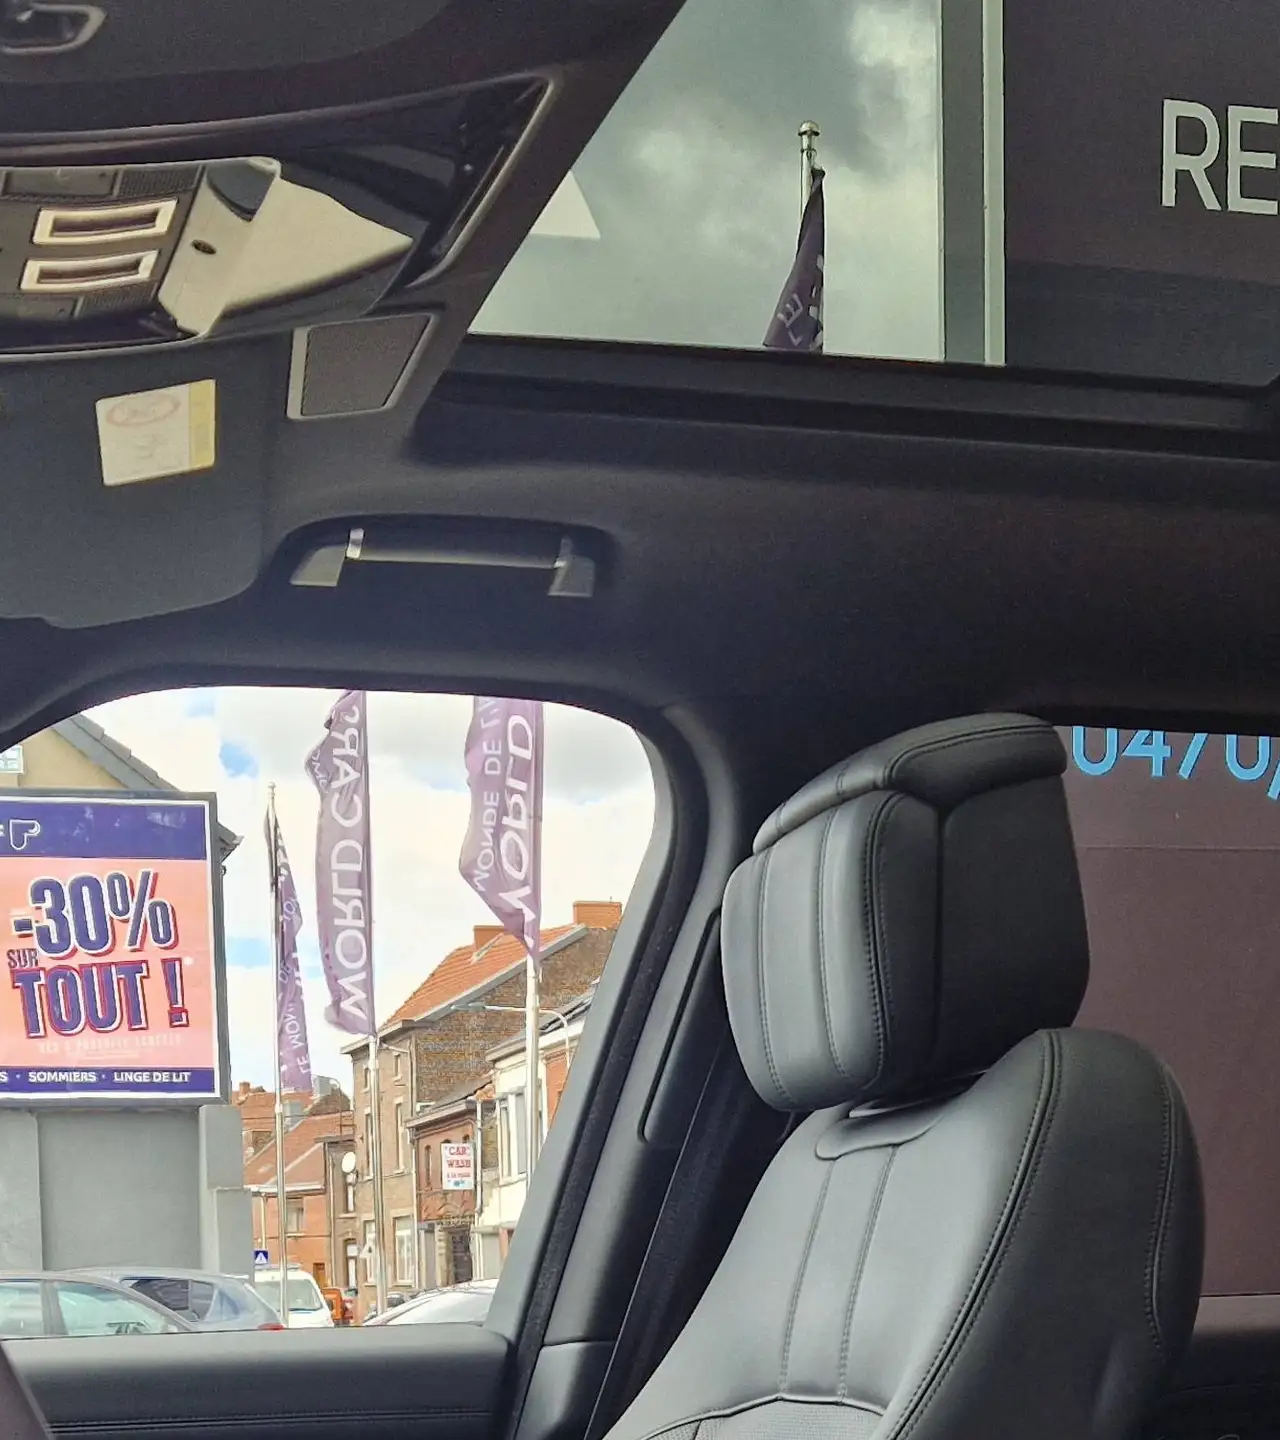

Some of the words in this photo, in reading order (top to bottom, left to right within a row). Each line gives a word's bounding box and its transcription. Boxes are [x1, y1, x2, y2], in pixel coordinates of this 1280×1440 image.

[12, 868, 178, 957] -30%
[7, 948, 38, 968] SUR
[10, 960, 149, 1038] TOUT
[161, 957, 189, 1027] !
[28, 1071, 97, 1083] SOMMIERS
[113, 1072, 150, 1083] LINGE
[152, 1072, 171, 1083] DE
[172, 1072, 191, 1083] LIT
